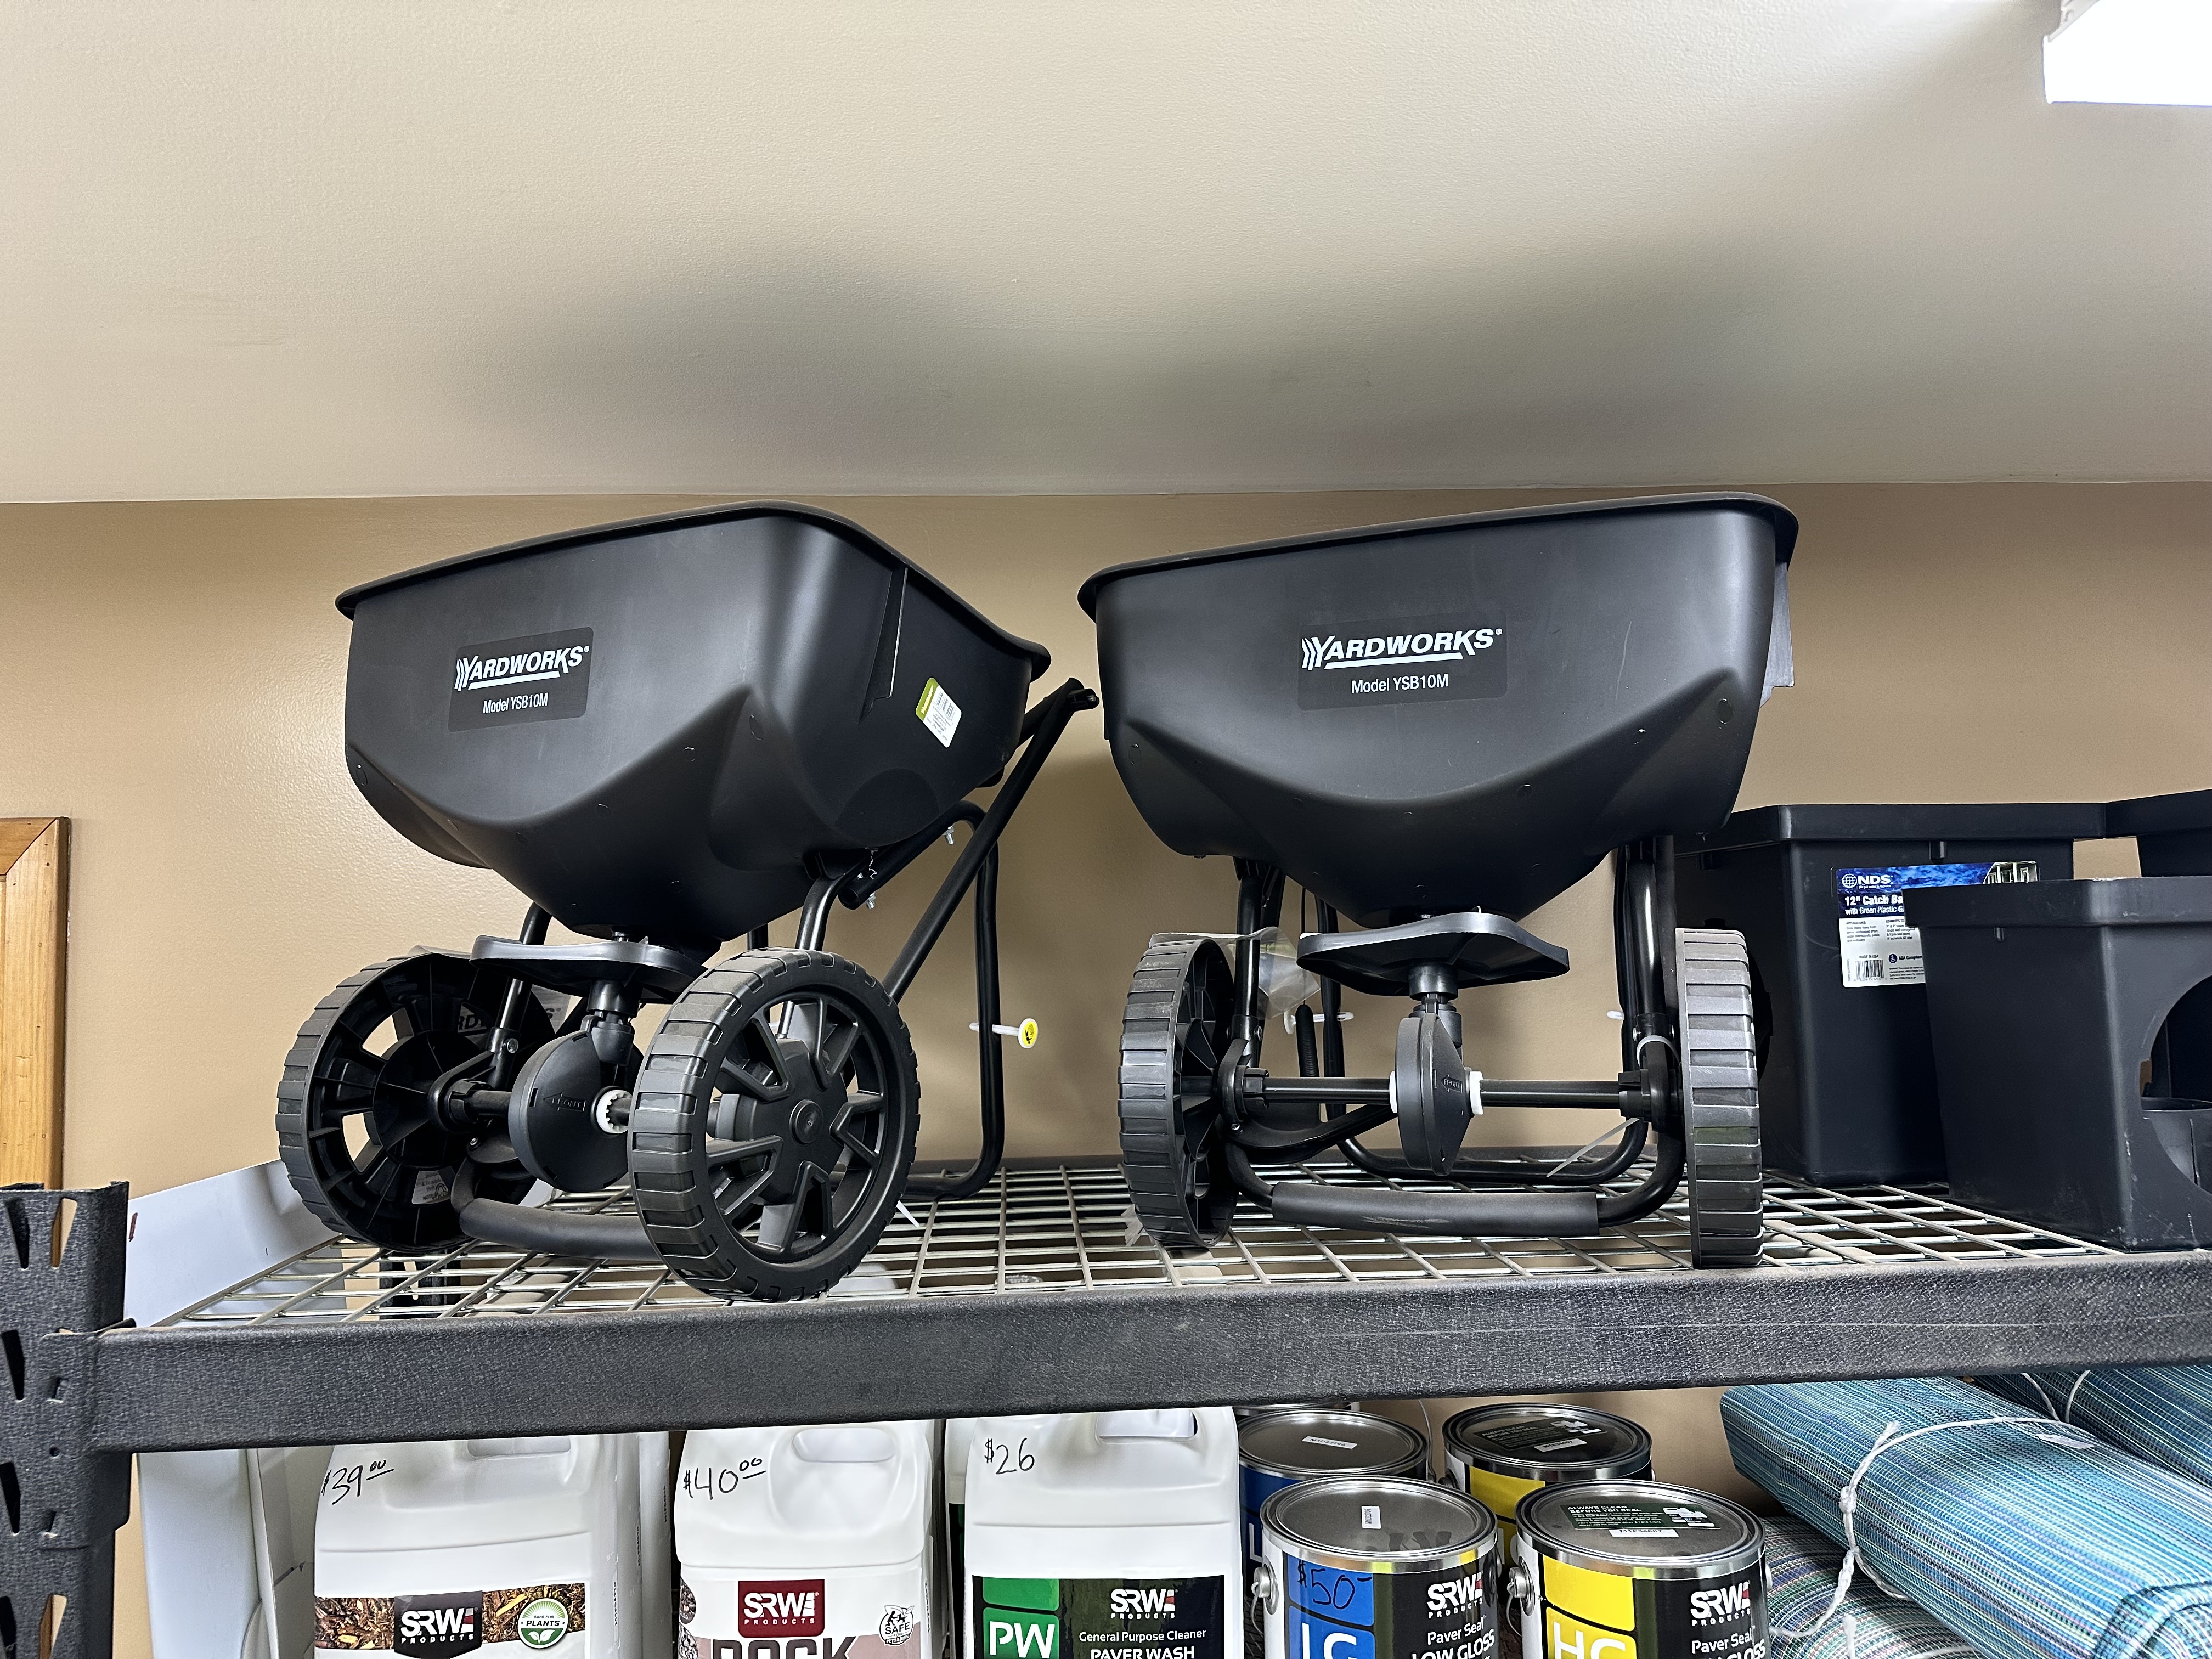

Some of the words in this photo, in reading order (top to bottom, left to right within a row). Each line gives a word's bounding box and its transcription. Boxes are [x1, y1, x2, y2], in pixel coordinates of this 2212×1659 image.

[1351, 678, 1390, 693] Model
[1392, 674, 1448, 692] YSB10M
[483, 697, 509, 714] Model
[511, 692, 548, 710] YSB10M
[1858, 875, 1891, 885] NDS
[1845, 896, 1860, 906] 12"
[1863, 895, 1889, 905] Catch
[984, 1437, 1035, 1475] $26
[1428, 1598, 1483, 1619] PRODUCTS
[1691, 1608, 1751, 1627] PRODUCTS
[885, 1622, 910, 1635] SAFE
[1079, 1632, 1119, 1641] General
[1122, 1632, 1164, 1644] Purpose
[1167, 1630, 1206, 1640] Cleaner
[1427, 1628, 1462, 1645] Paver
[1464, 1616, 1483, 1637] Seal
[401, 1634, 474, 1644] PRODUCTS
[989, 1621, 1055, 1659] PW
[1457, 1628, 1494, 1659] GLOSS
[1691, 1639, 1729, 1654] Paver
[1731, 1627, 1752, 1647] Seal
[1091, 1649, 1143, 1659] PAVER
[1146, 1646, 1195, 1659] WASH
